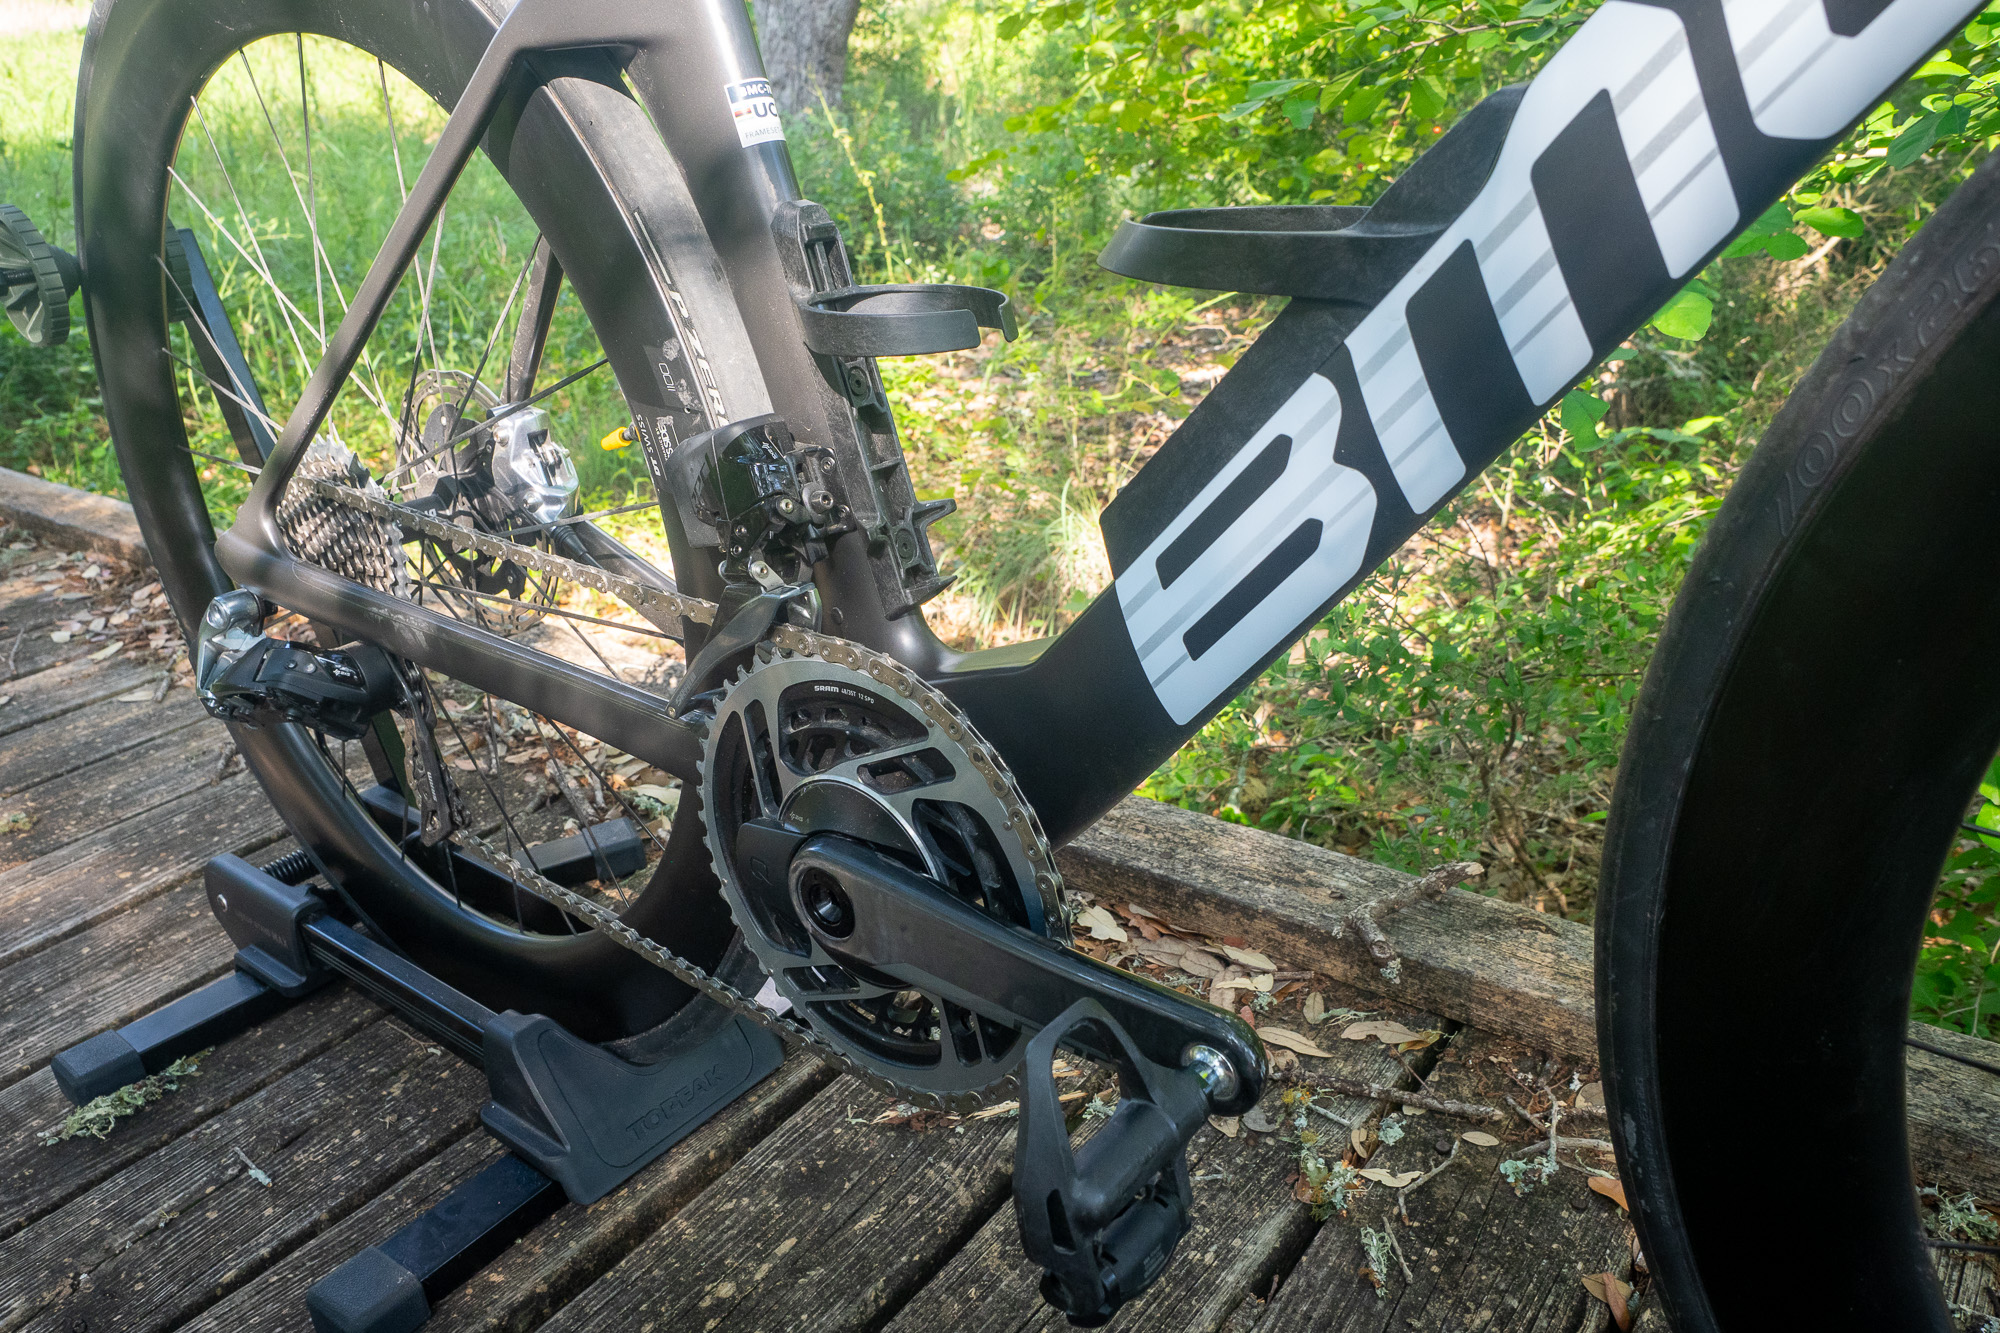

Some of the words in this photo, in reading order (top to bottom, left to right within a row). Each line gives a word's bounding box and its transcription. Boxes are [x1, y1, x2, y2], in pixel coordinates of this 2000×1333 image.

[669, 290, 689, 318] P
[636, 413, 653, 454] SWISS
[650, 456, 661, 477] DT
[814, 685, 839, 693] SRAM
[864, 695, 874, 704] SPD
[626, 1063, 723, 1140] TOPEAK
